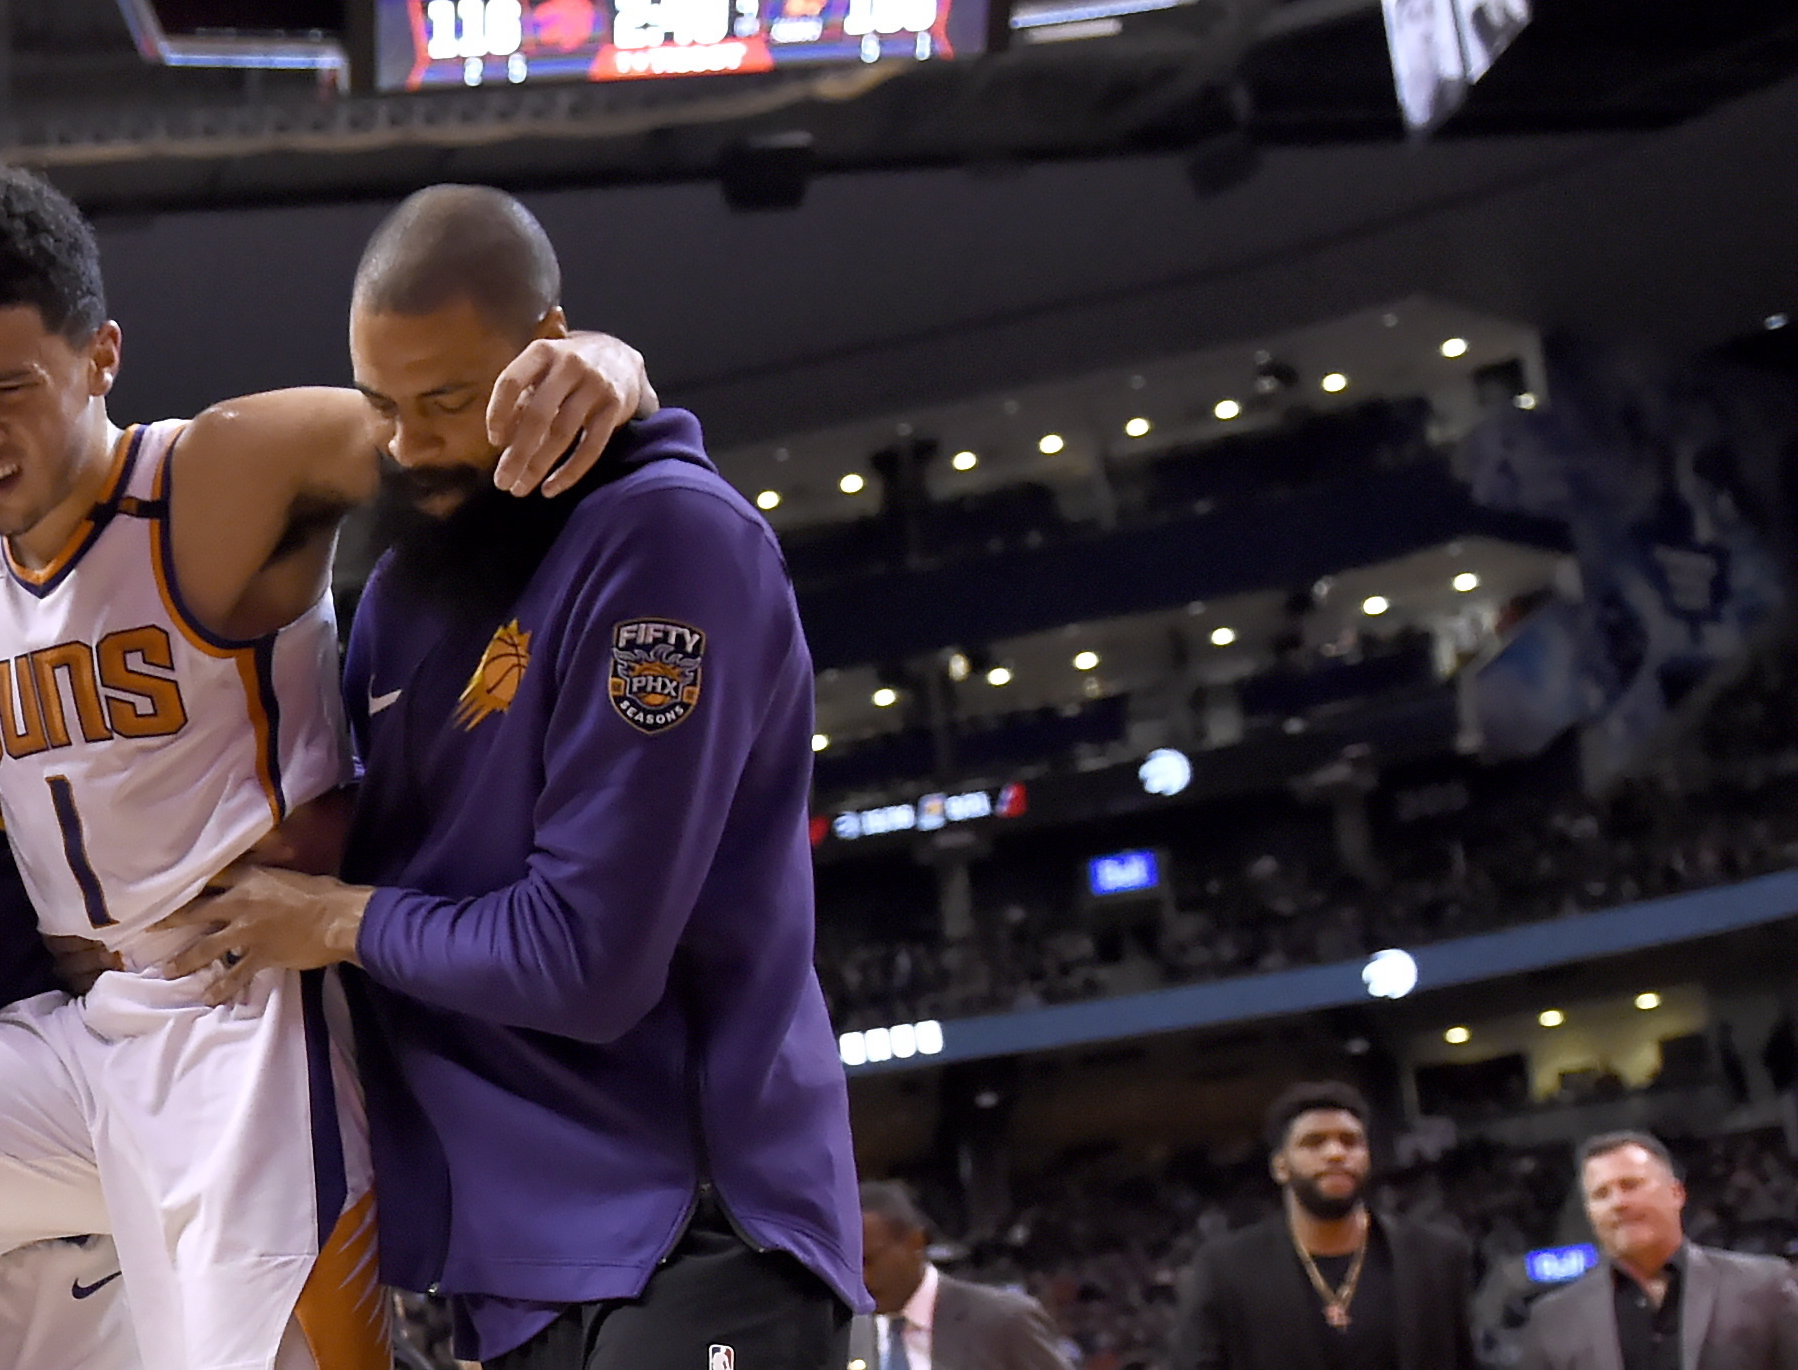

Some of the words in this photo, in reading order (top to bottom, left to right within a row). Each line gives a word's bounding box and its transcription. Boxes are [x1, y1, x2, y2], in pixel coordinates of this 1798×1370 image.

[618, 623, 700, 653] FIFTY
[631, 676, 678, 697] PHX
[619, 700, 685, 725] SEASONS
[45, 774, 120, 929] 1
